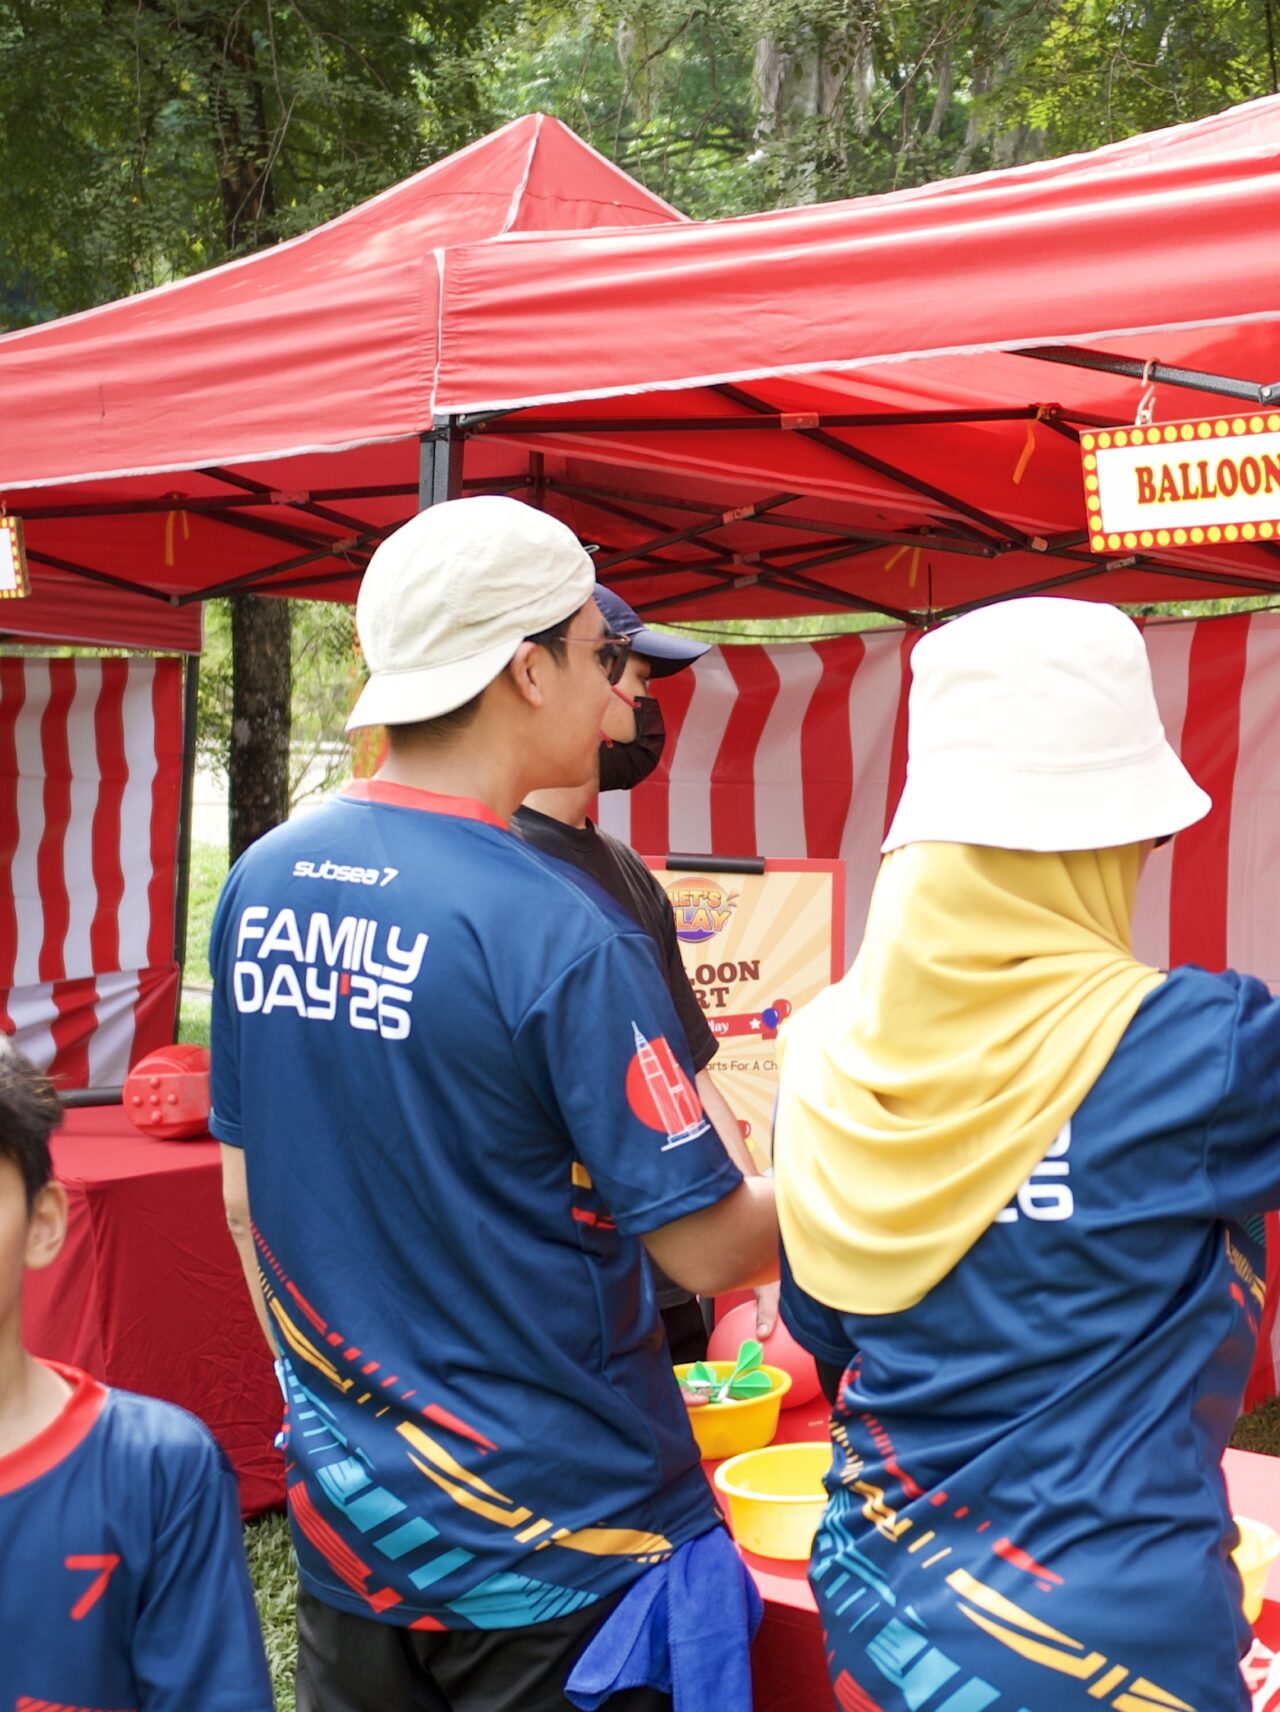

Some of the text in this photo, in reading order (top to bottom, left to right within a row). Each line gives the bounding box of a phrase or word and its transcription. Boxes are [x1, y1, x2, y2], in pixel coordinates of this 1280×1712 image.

[674, 907, 732, 932] LAY
[237, 906, 430, 984] FAMILY
[730, 1060, 750, 1071] For
[752, 1060, 760, 1071] A
[64, 1553, 121, 1622] 7
